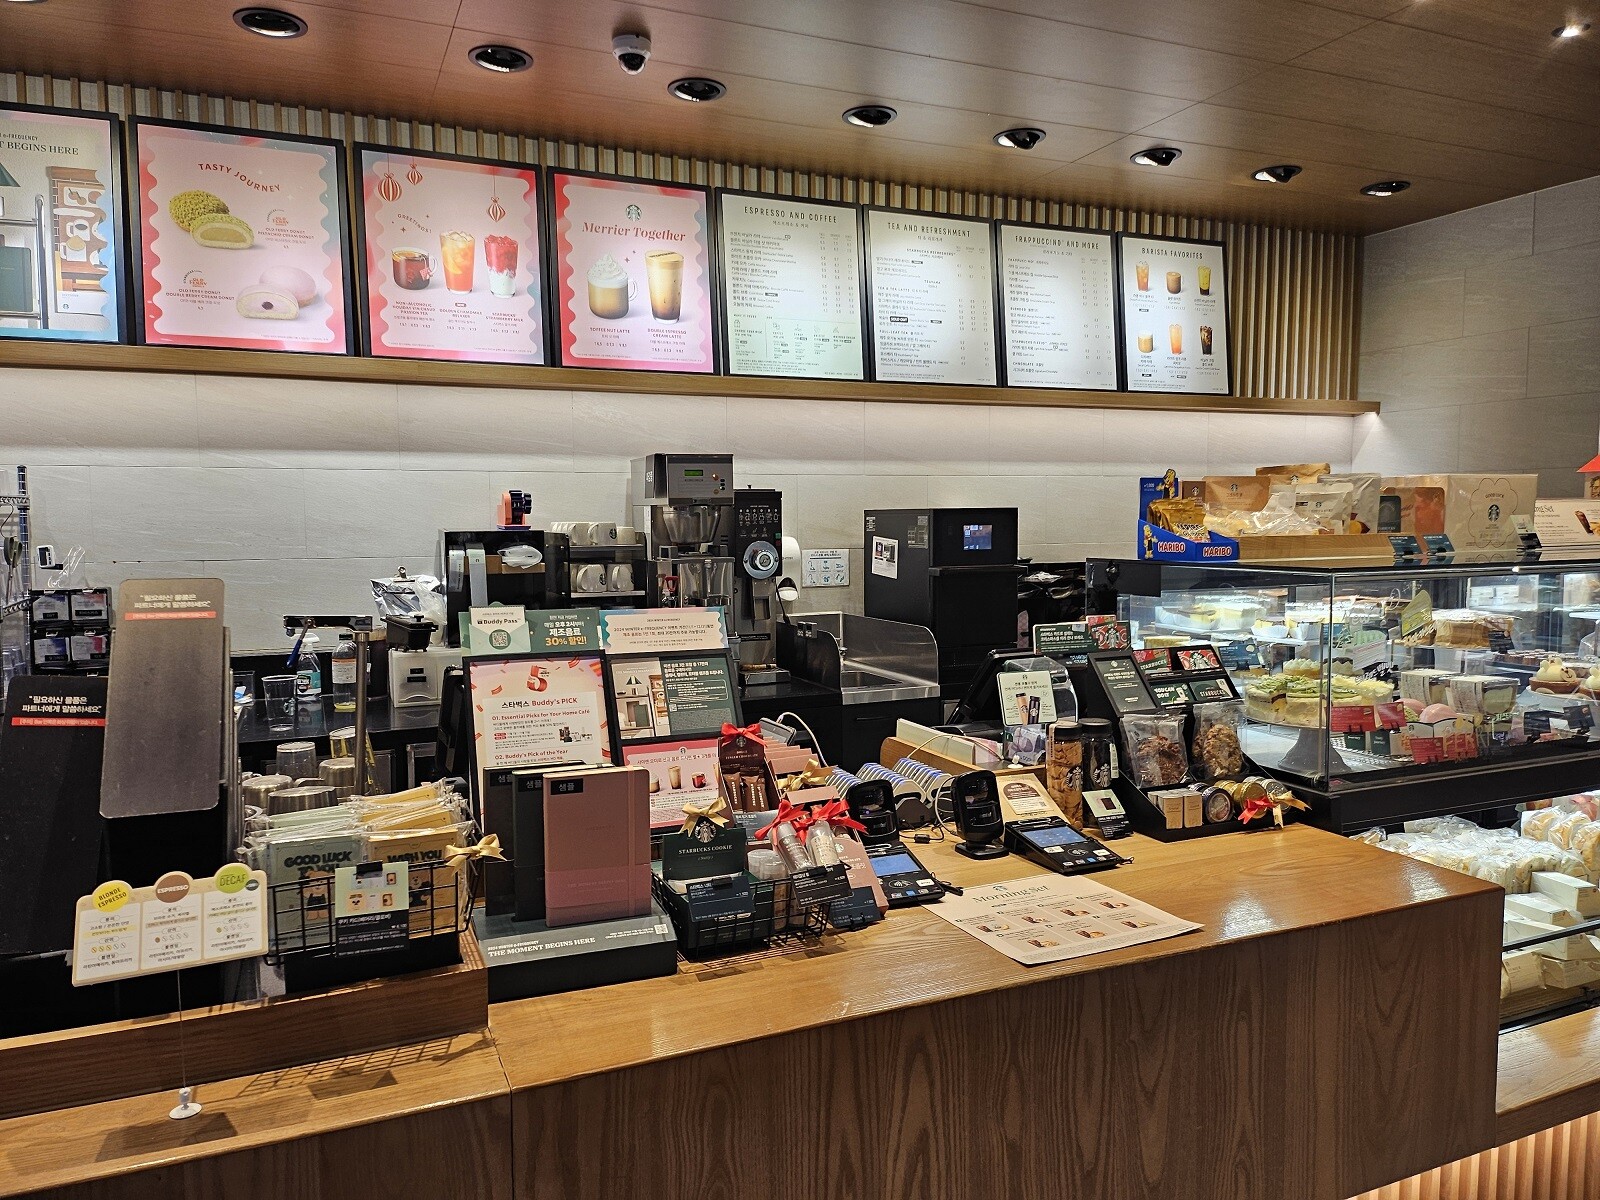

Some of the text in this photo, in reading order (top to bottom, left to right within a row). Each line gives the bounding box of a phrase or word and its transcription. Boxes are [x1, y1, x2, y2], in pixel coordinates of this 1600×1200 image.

[7, 141, 47, 152] BEGINS
[49, 145, 79, 155] HERE
[198, 162, 281, 192] TASTY JOURNEY
[744, 206, 837, 223] ESPRESSO AND COFFEE
[582, 222, 686, 242] Merrier Together
[888, 222, 971, 238] TEA AND REFRESHMENT
[1066, 238, 1099, 250] AND MORE
[1141, 247, 1203, 260] BARISTA FAVORITES
[1158, 541, 1186, 553] HARIBO
[1203, 546, 1233, 558] HARIBO
[549, 628, 581, 636] 제조음료
[545, 636, 587, 646] 30% 할인!
[1140, 659, 1167, 670] STARBUCKS
[1199, 690, 1226, 698] STARBUCKS
[501, 701, 530, 709] 스타벅스
[531, 698, 561, 708] Buddy's
[505, 752, 527, 760] Buddy's
[498, 774, 513, 783] 샘플
[526, 779, 543, 788] 샘플
[558, 782, 575, 791] 샘플
[387, 849, 442, 863] WISH YOU
[678, 846, 711, 855] STARBUCKS
[283, 850, 353, 868] GOOD LUCK
[219, 873, 247, 887] DECAF
[98, 886, 121, 901] BLONDE
[157, 884, 189, 894] ESPRESSO
[971, 884, 1050, 903] Morning Set
[98, 891, 127, 908] ESPRESSO
[487, 937, 596, 958] THE MOMENT BEGINS HERE
